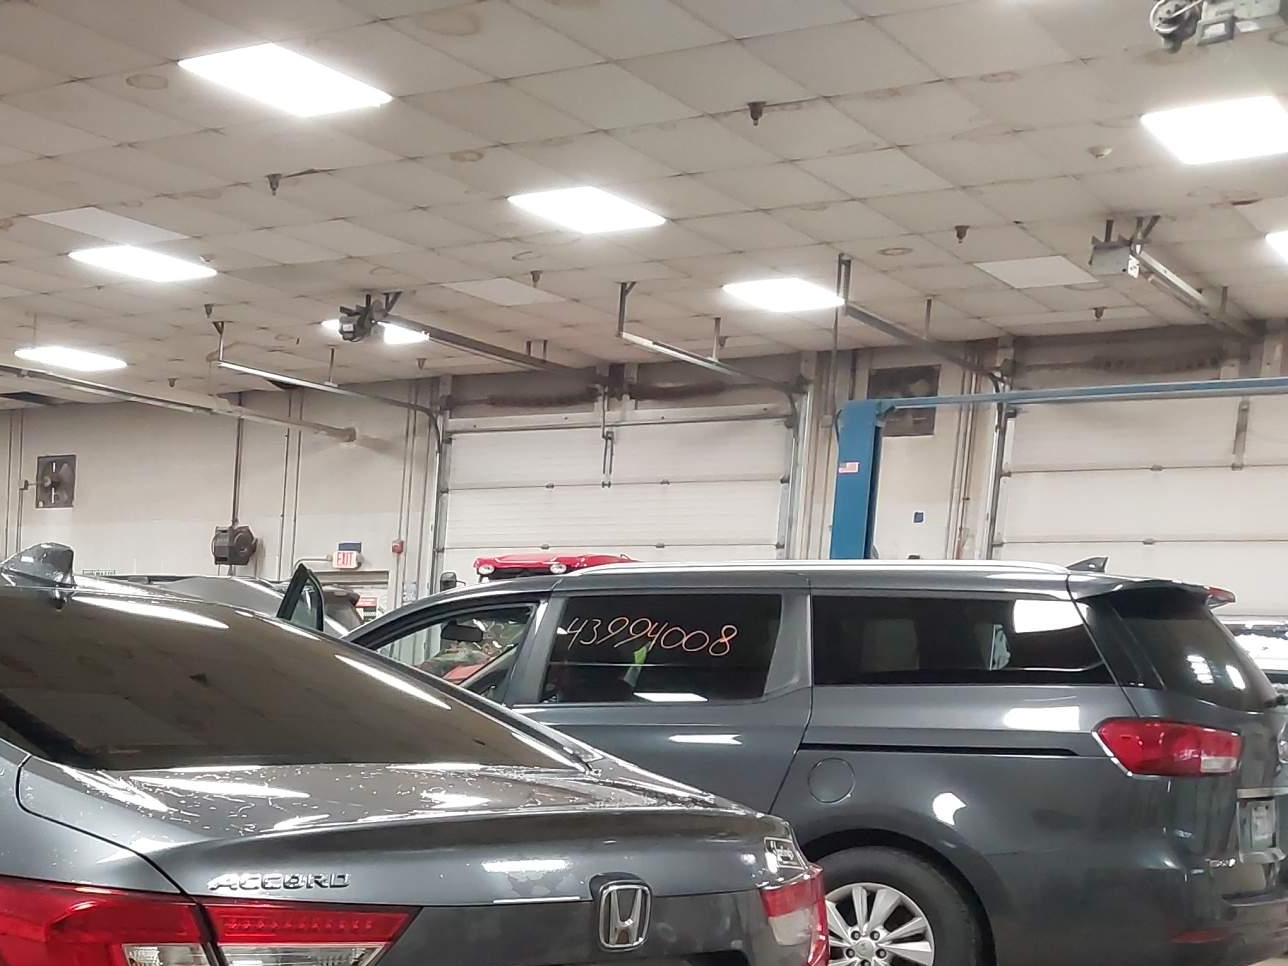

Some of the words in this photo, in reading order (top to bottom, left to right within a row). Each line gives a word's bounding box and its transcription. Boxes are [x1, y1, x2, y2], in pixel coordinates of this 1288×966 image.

[337, 551, 354, 567] EXIT
[566, 616, 738, 657] 43994008
[208, 871, 350, 891] ACCORD
